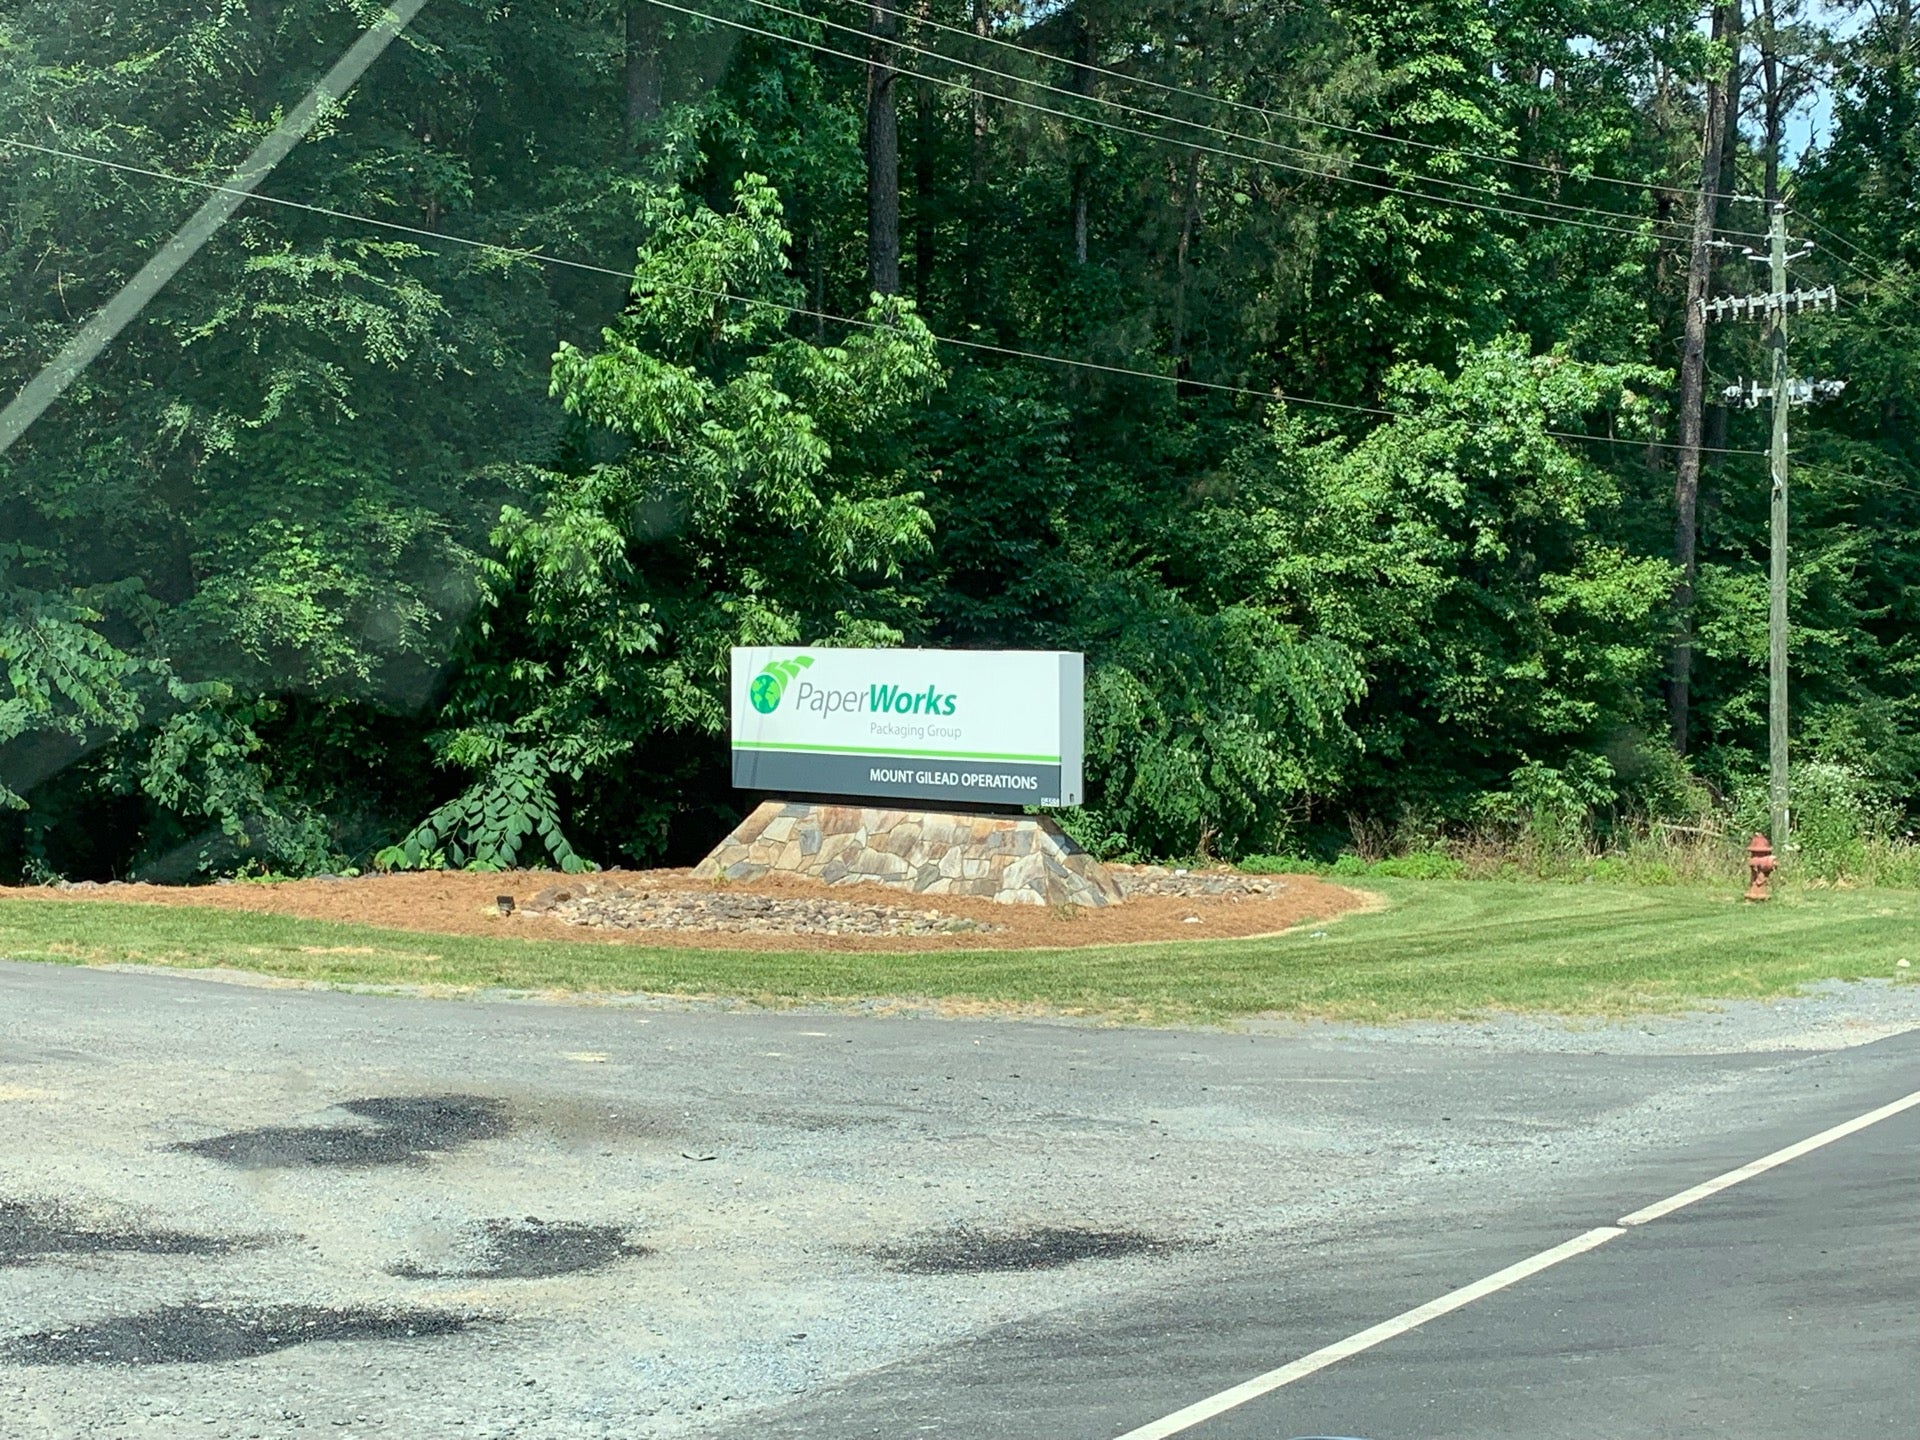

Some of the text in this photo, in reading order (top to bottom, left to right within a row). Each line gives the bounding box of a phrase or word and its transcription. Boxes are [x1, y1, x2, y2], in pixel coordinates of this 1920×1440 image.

[796, 682, 957, 718] PaperWorks
[870, 722, 962, 740] Packaging Group
[869, 768, 1038, 790] MOUNT GILEAD OPERATIONS
